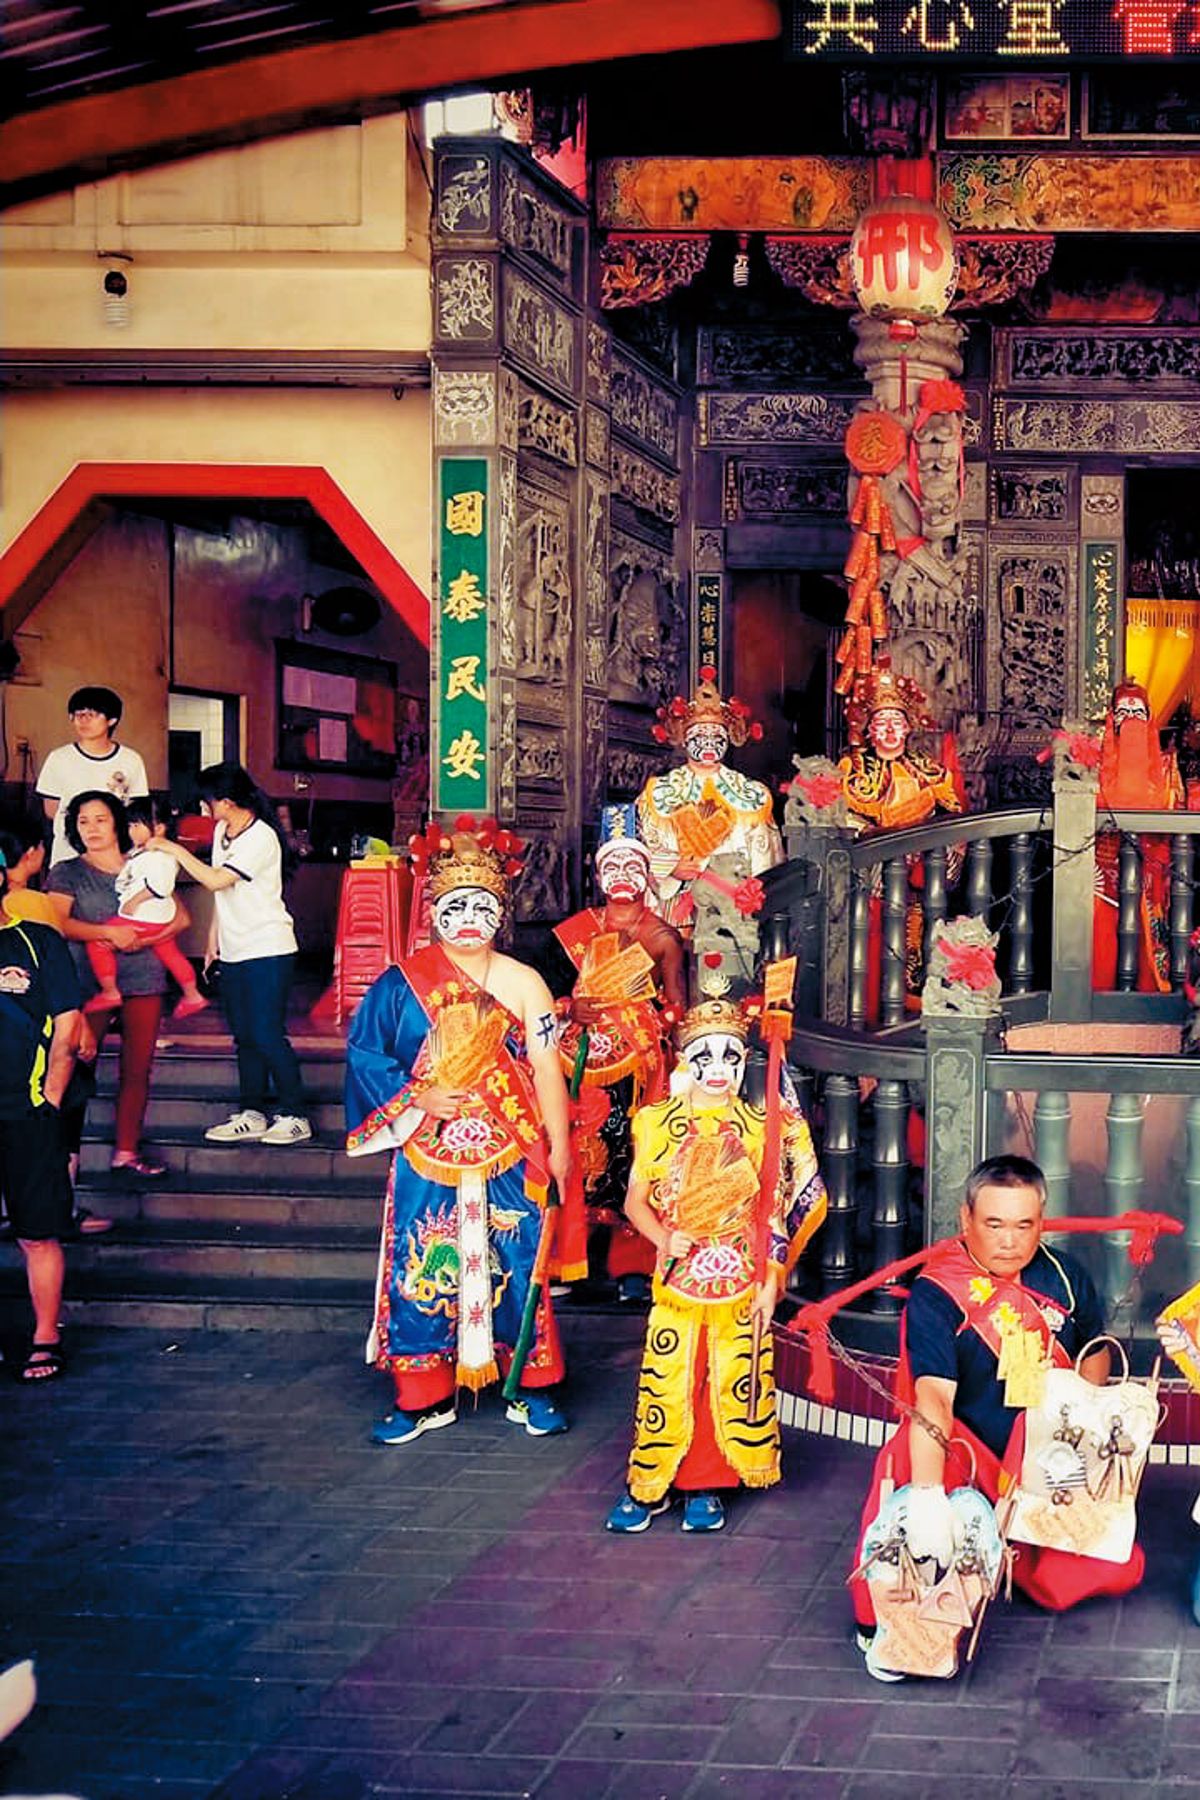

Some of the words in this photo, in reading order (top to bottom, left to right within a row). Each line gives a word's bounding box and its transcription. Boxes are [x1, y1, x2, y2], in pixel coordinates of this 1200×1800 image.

[804, 0, 1070, 53] 共心堂
[442, 490, 486, 780] 國泰民安
